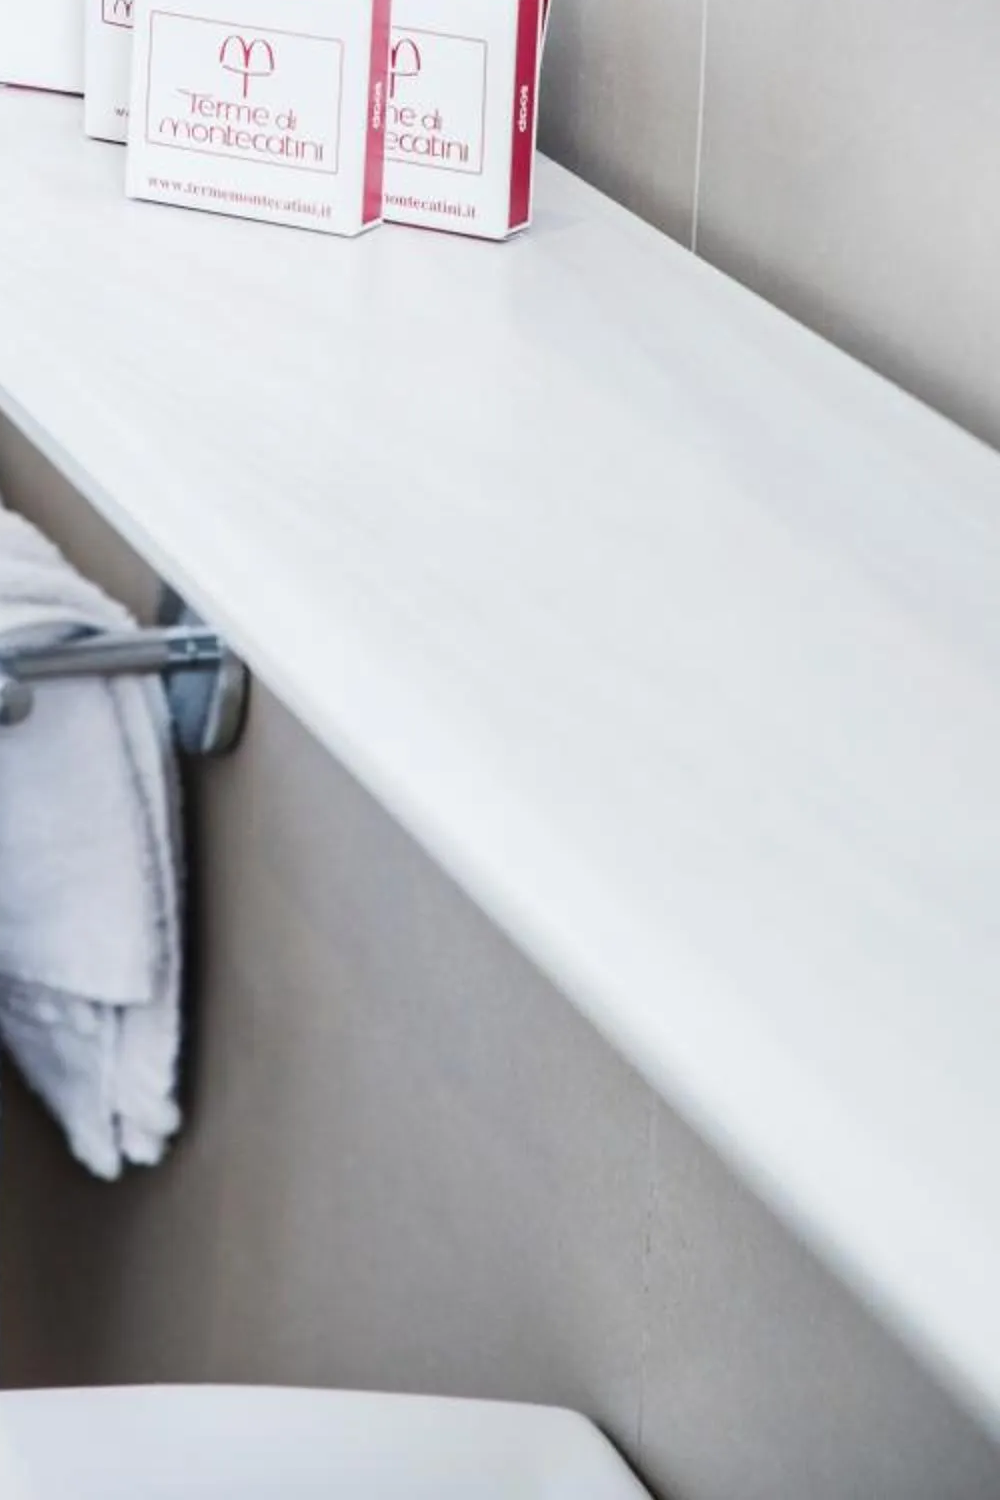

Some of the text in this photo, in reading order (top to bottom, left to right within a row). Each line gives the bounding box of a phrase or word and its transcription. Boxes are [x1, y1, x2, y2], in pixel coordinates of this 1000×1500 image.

[175, 87, 298, 132] Terme di
[421, 108, 442, 131] di
